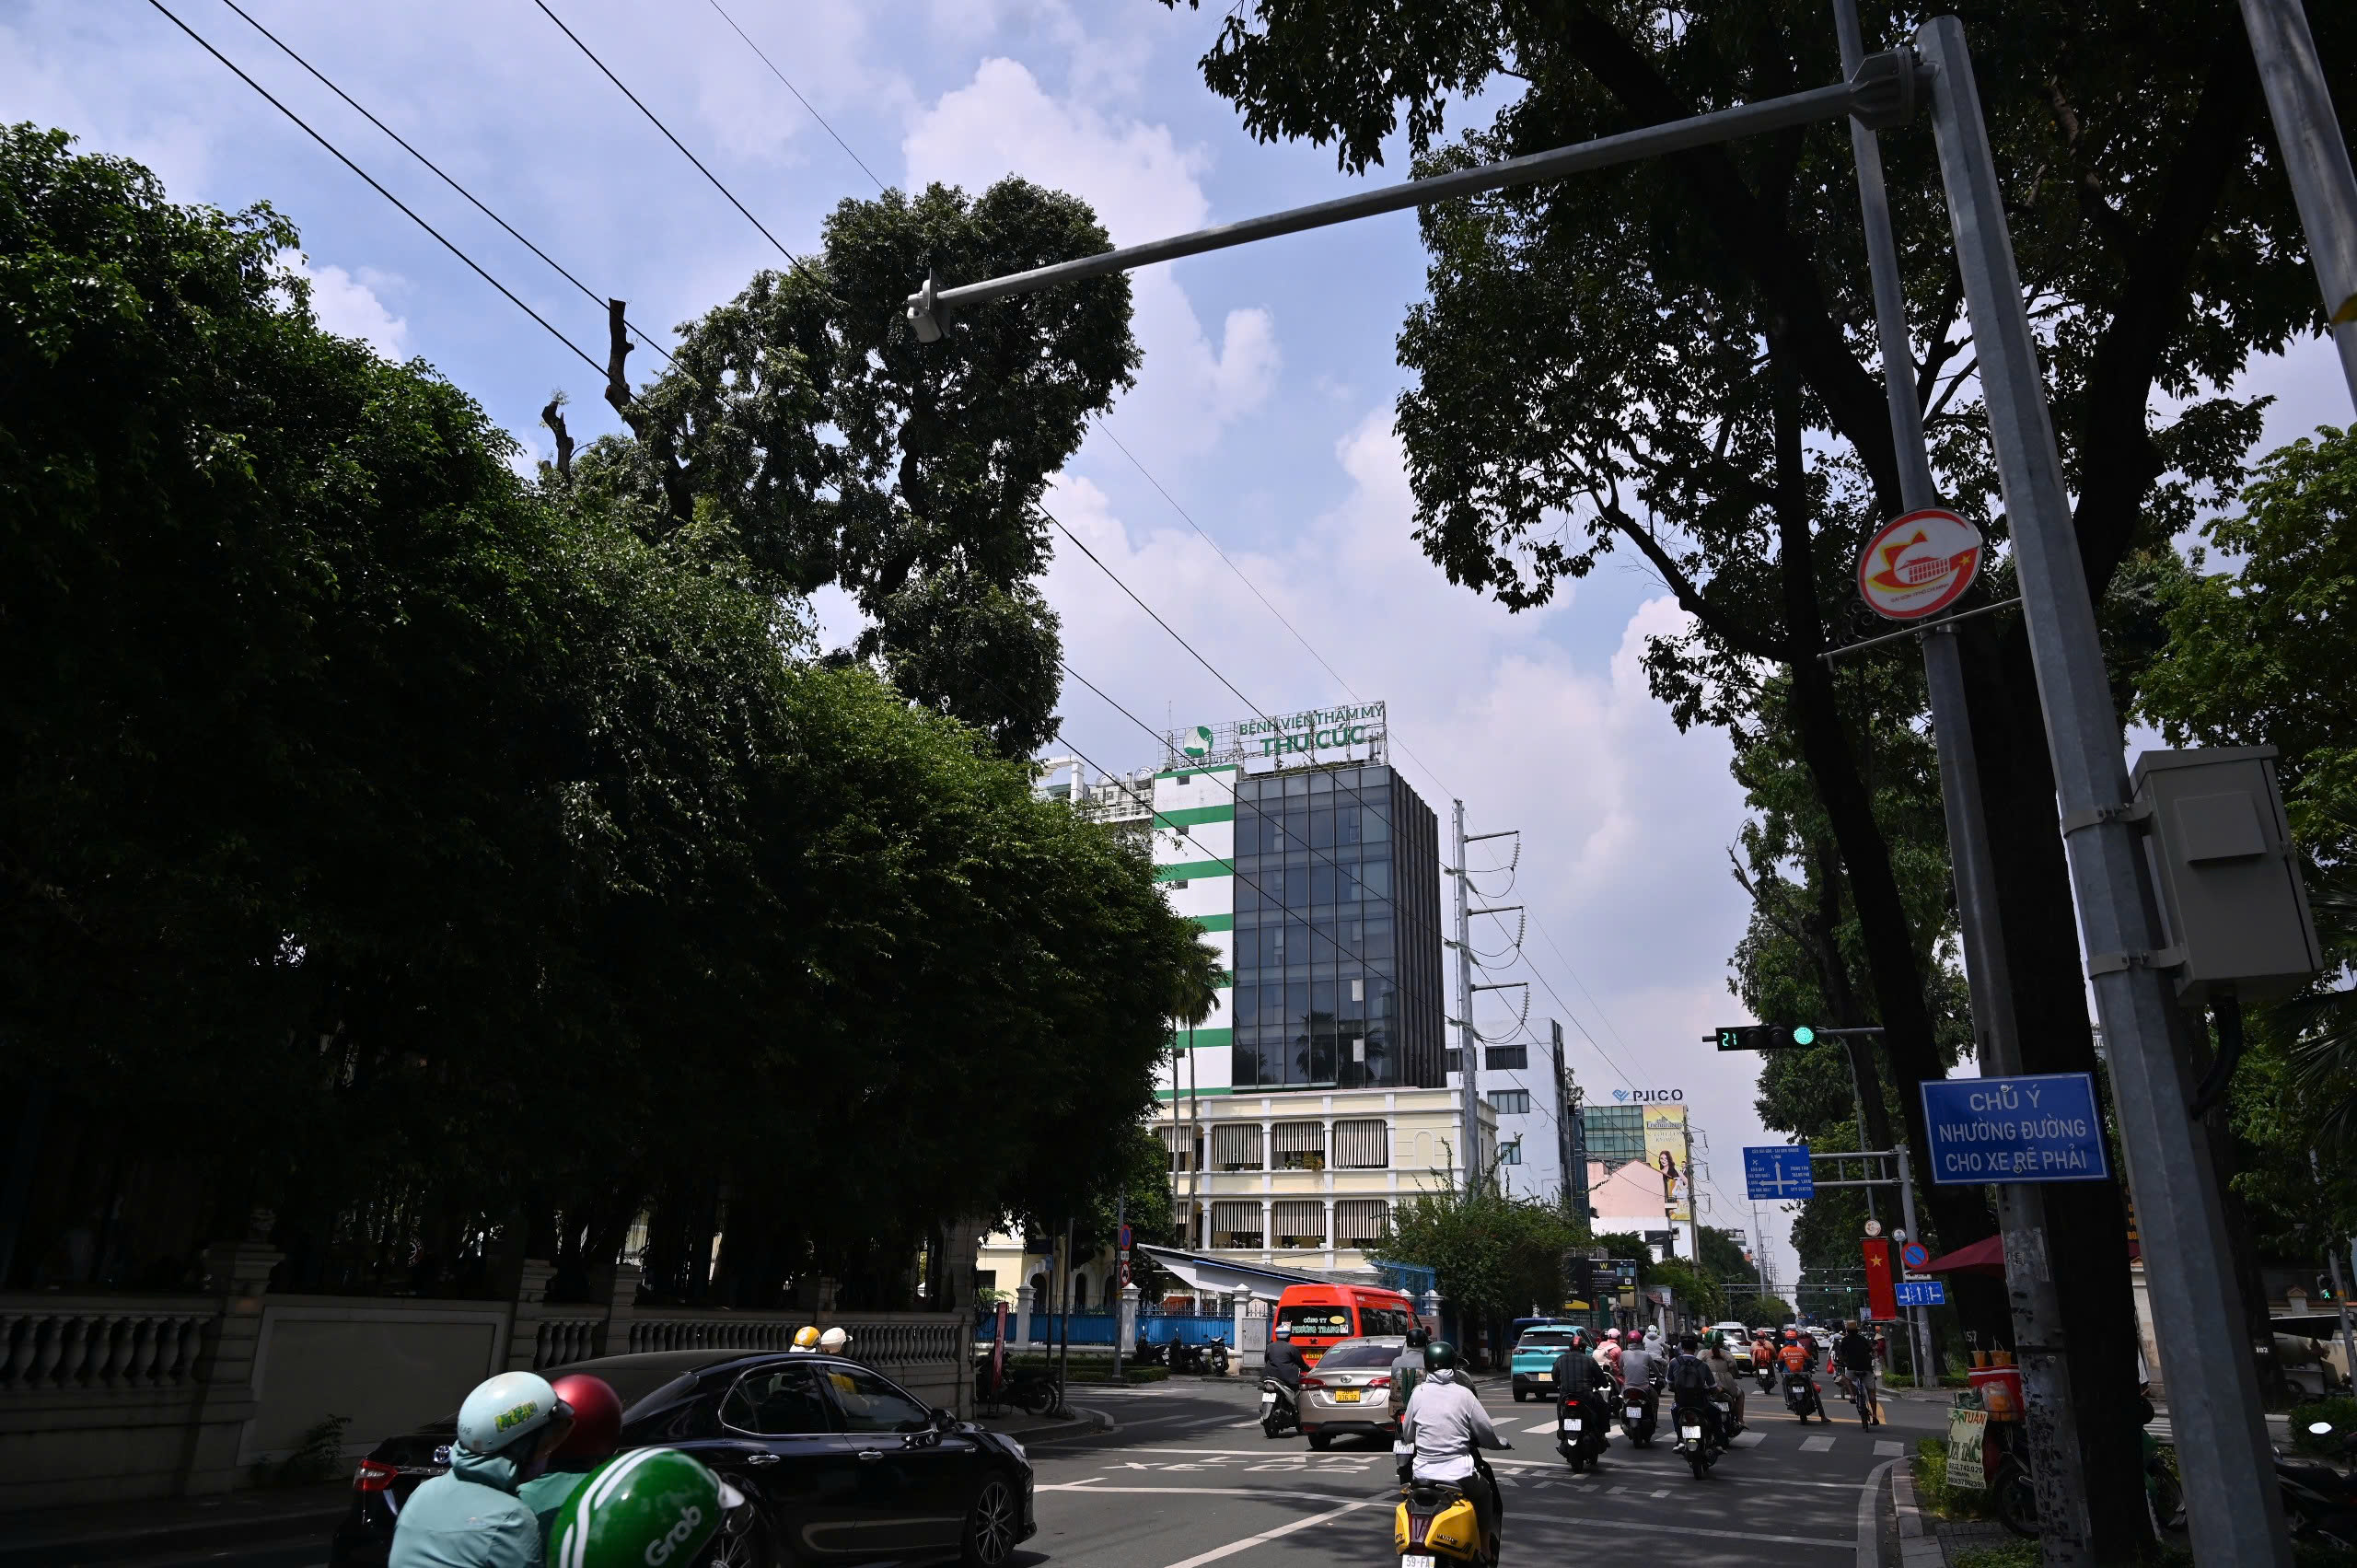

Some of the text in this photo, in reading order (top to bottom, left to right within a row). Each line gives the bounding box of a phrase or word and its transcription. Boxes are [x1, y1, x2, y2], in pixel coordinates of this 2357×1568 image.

[1260, 723, 1365, 757] THU CÚC
[1722, 1032, 1737, 1047] 21
[1632, 1089, 1683, 1101] PJICO
[1969, 1084, 2041, 1111] CHÚ Ý
[1939, 1113, 2086, 1143] NHƯỜNG ĐƯỜNG
[1945, 1144, 2087, 1172] CHO XE RẼ PHẢI
[644, 1505, 702, 1567] Grab
